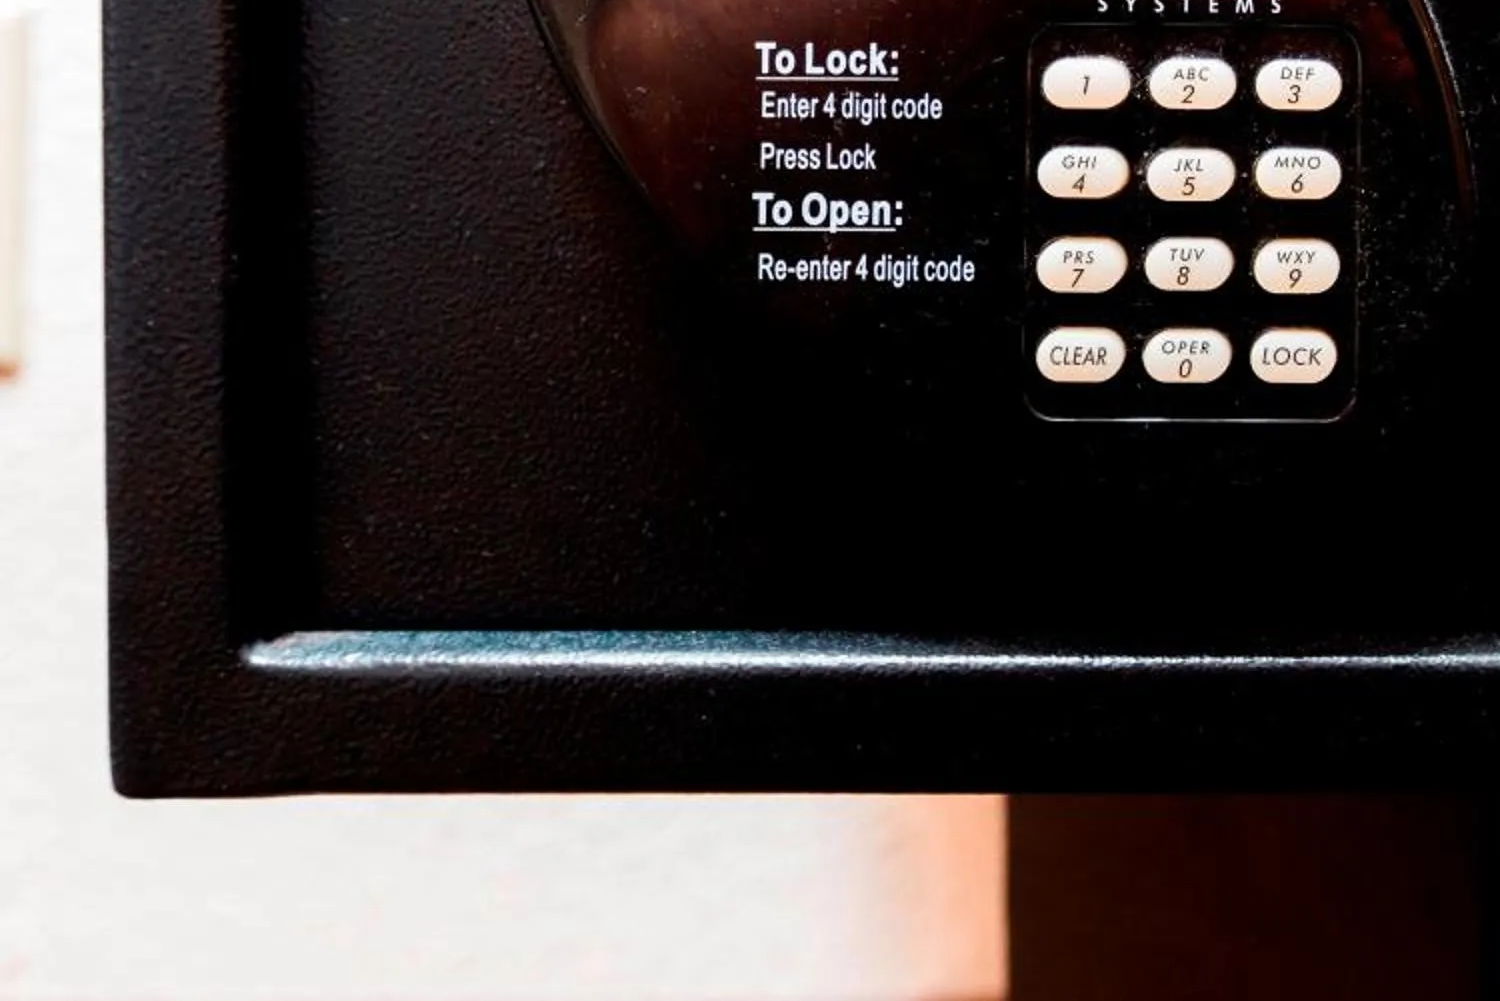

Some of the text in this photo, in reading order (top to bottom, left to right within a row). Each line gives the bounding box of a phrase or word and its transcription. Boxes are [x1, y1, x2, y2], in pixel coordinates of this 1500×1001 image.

[755, 41, 899, 76] To Lock:
[1173, 66, 1210, 81] ABC
[1280, 66, 1316, 81] DEF
[1080, 75, 1091, 96] 1
[1181, 84, 1195, 104] 2
[1286, 84, 1301, 104] 3
[761, 90, 943, 126] Enter 4 digit code
[760, 141, 877, 170] Press Lock
[1061, 155, 1098, 170] GHI
[1173, 158, 1205, 173] JKL
[1273, 156, 1322, 170] MNO
[1072, 174, 1086, 194] 4
[1181, 176, 1196, 197] 5
[1290, 174, 1305, 194] 6
[752, 192, 904, 233] To Open:
[1063, 250, 1095, 265] PRS
[1169, 247, 1206, 263] TUV
[1276, 250, 1317, 265] WXY
[758, 252, 976, 288] Re-enter 4 digit code
[1071, 268, 1086, 288] 7
[1176, 265, 1190, 287] 8
[1288, 269, 1302, 289] 9
[1050, 345, 1108, 366] CLEAR
[1161, 339, 1212, 355] OPER
[1261, 346, 1323, 367] LOCK
[1178, 358, 1194, 379] 0
